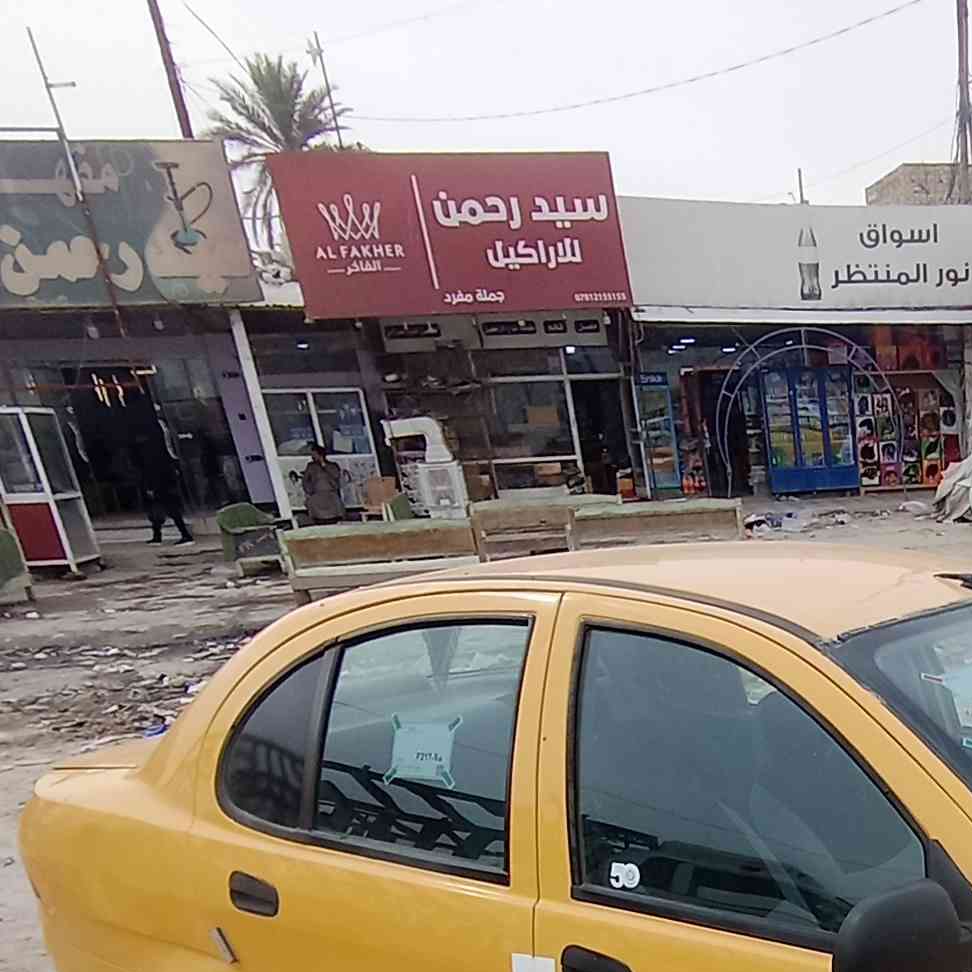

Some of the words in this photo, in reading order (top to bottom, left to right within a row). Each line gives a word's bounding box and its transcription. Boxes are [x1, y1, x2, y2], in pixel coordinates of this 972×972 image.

[431, 190, 522, 230] رحمن
[531, 193, 609, 230] سيد
[859, 223, 938, 249] اسواق
[316, 248, 337, 260] AL
[340, 244, 406, 259] FAKHER
[485, 238, 583, 271] للاراكيل
[345, 260, 382, 275] الفاخر
[831, 262, 928, 289] المنتظر
[935, 262, 970, 287] نور
[443, 291, 473, 305] مفرد
[475, 289, 505, 305] جملة
